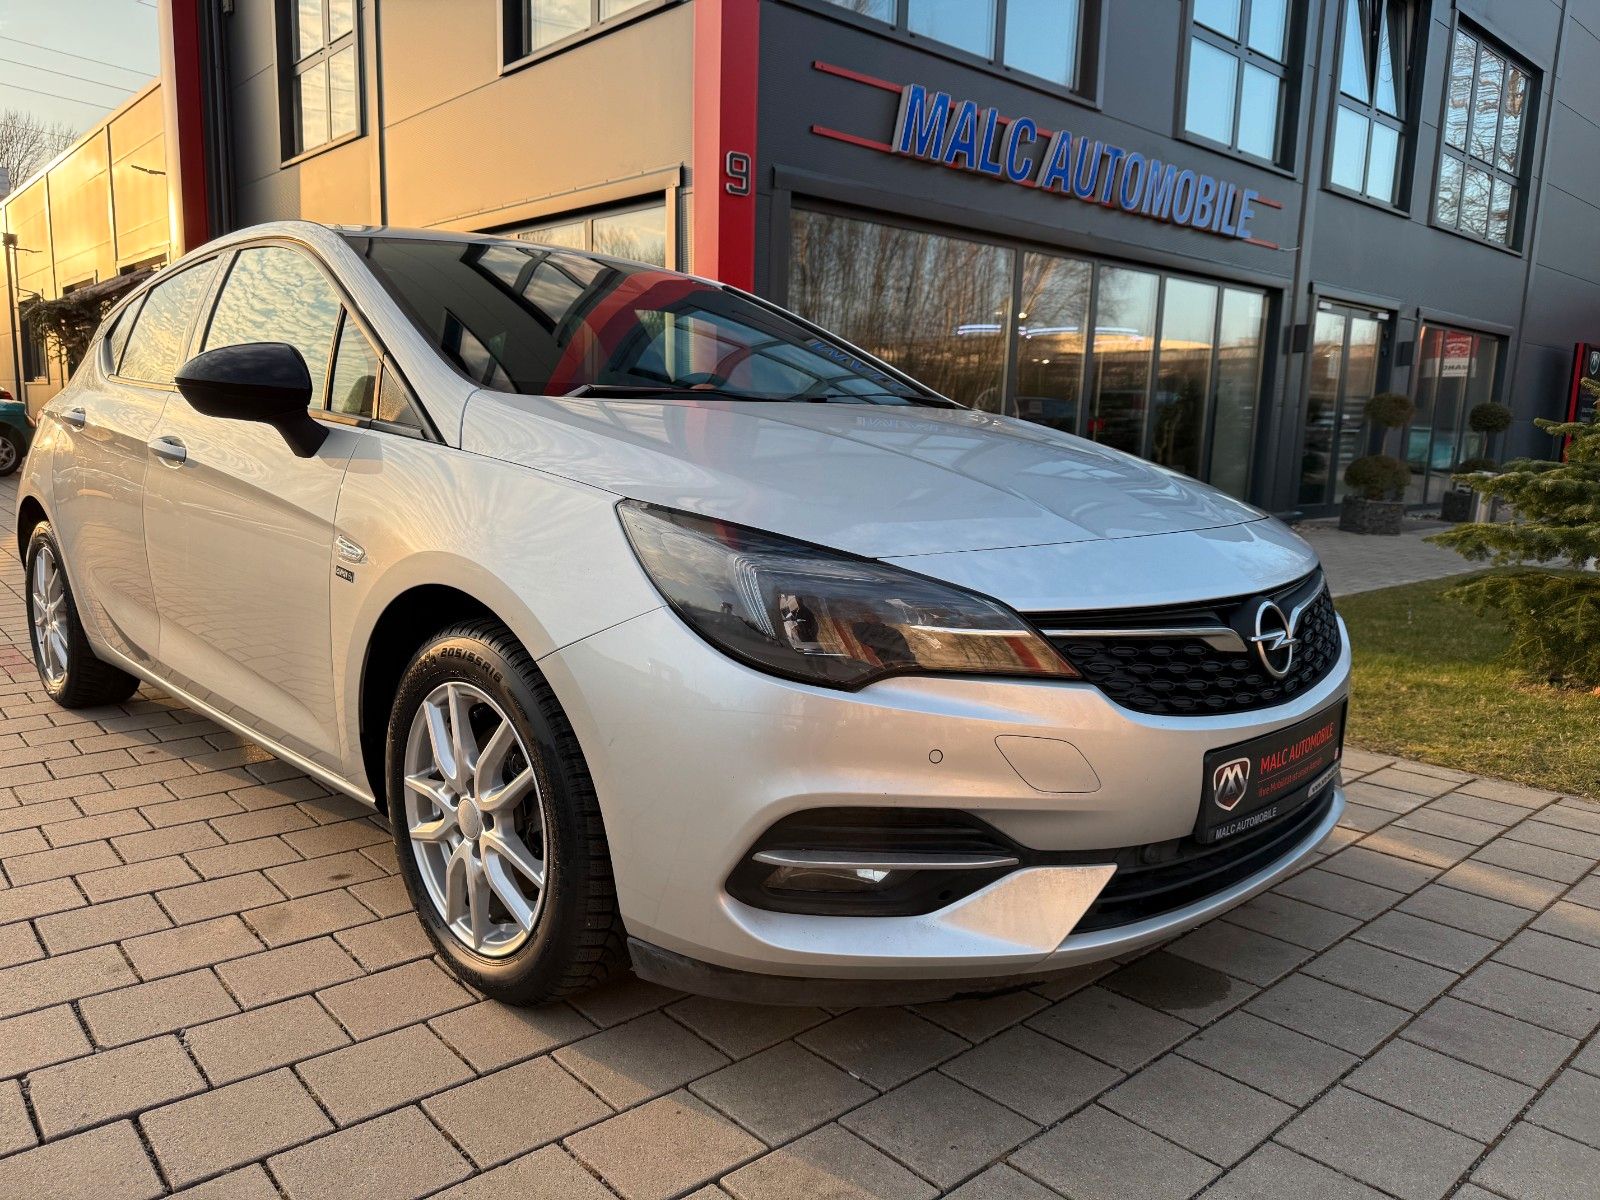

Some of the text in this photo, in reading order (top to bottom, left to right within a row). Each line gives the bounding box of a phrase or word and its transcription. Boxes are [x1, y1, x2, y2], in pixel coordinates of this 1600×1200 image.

[726, 150, 751, 196] 9
[897, 83, 1259, 239] MALC AUTOMOBILE
[440, 647, 503, 683] 205/55R16
[1260, 748, 1288, 775] MALC
[1288, 722, 1335, 763] AUTOMOBILE
[1215, 806, 1278, 840] MALC AUTOMOBILE
